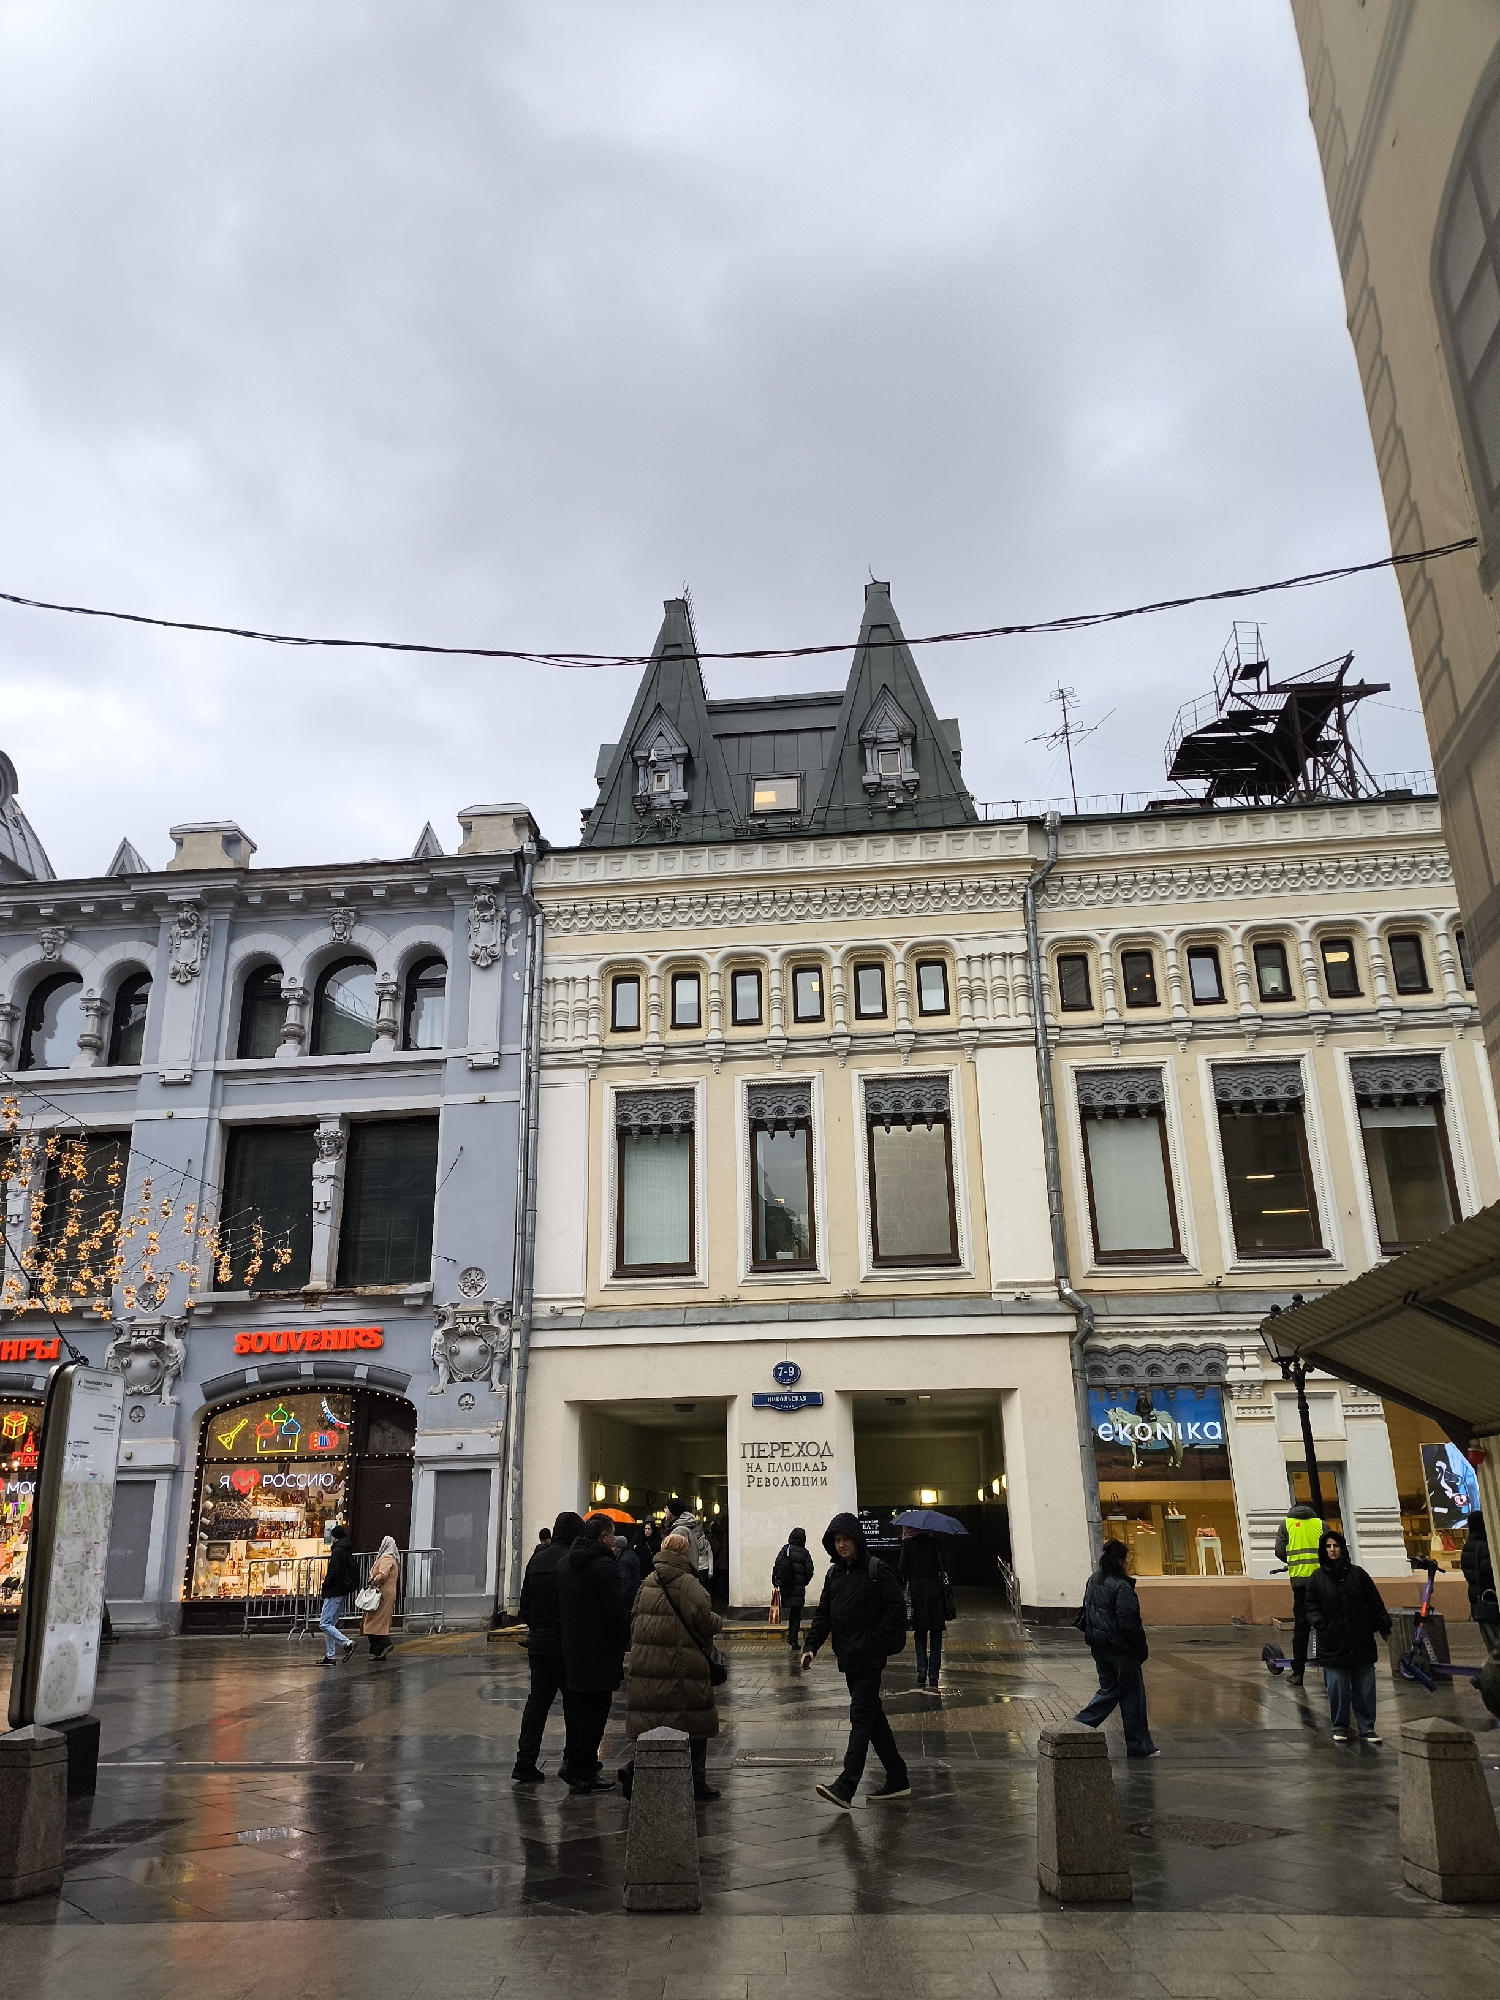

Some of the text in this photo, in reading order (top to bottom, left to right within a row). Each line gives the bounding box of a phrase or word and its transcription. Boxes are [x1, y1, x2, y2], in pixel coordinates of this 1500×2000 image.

[234, 1327, 384, 1354] SOUVENIRS
[0, 1338, 61, 1361] ИРЫ
[777, 1367, 795, 1377] 7-9
[740, 1440, 834, 1458] ПЕРЕХОД
[745, 1462, 763, 1473] НА
[219, 1473, 334, 1489] Я РОССИЮ
[746, 1474, 828, 1488] РЕВОЛЮЦИИ
